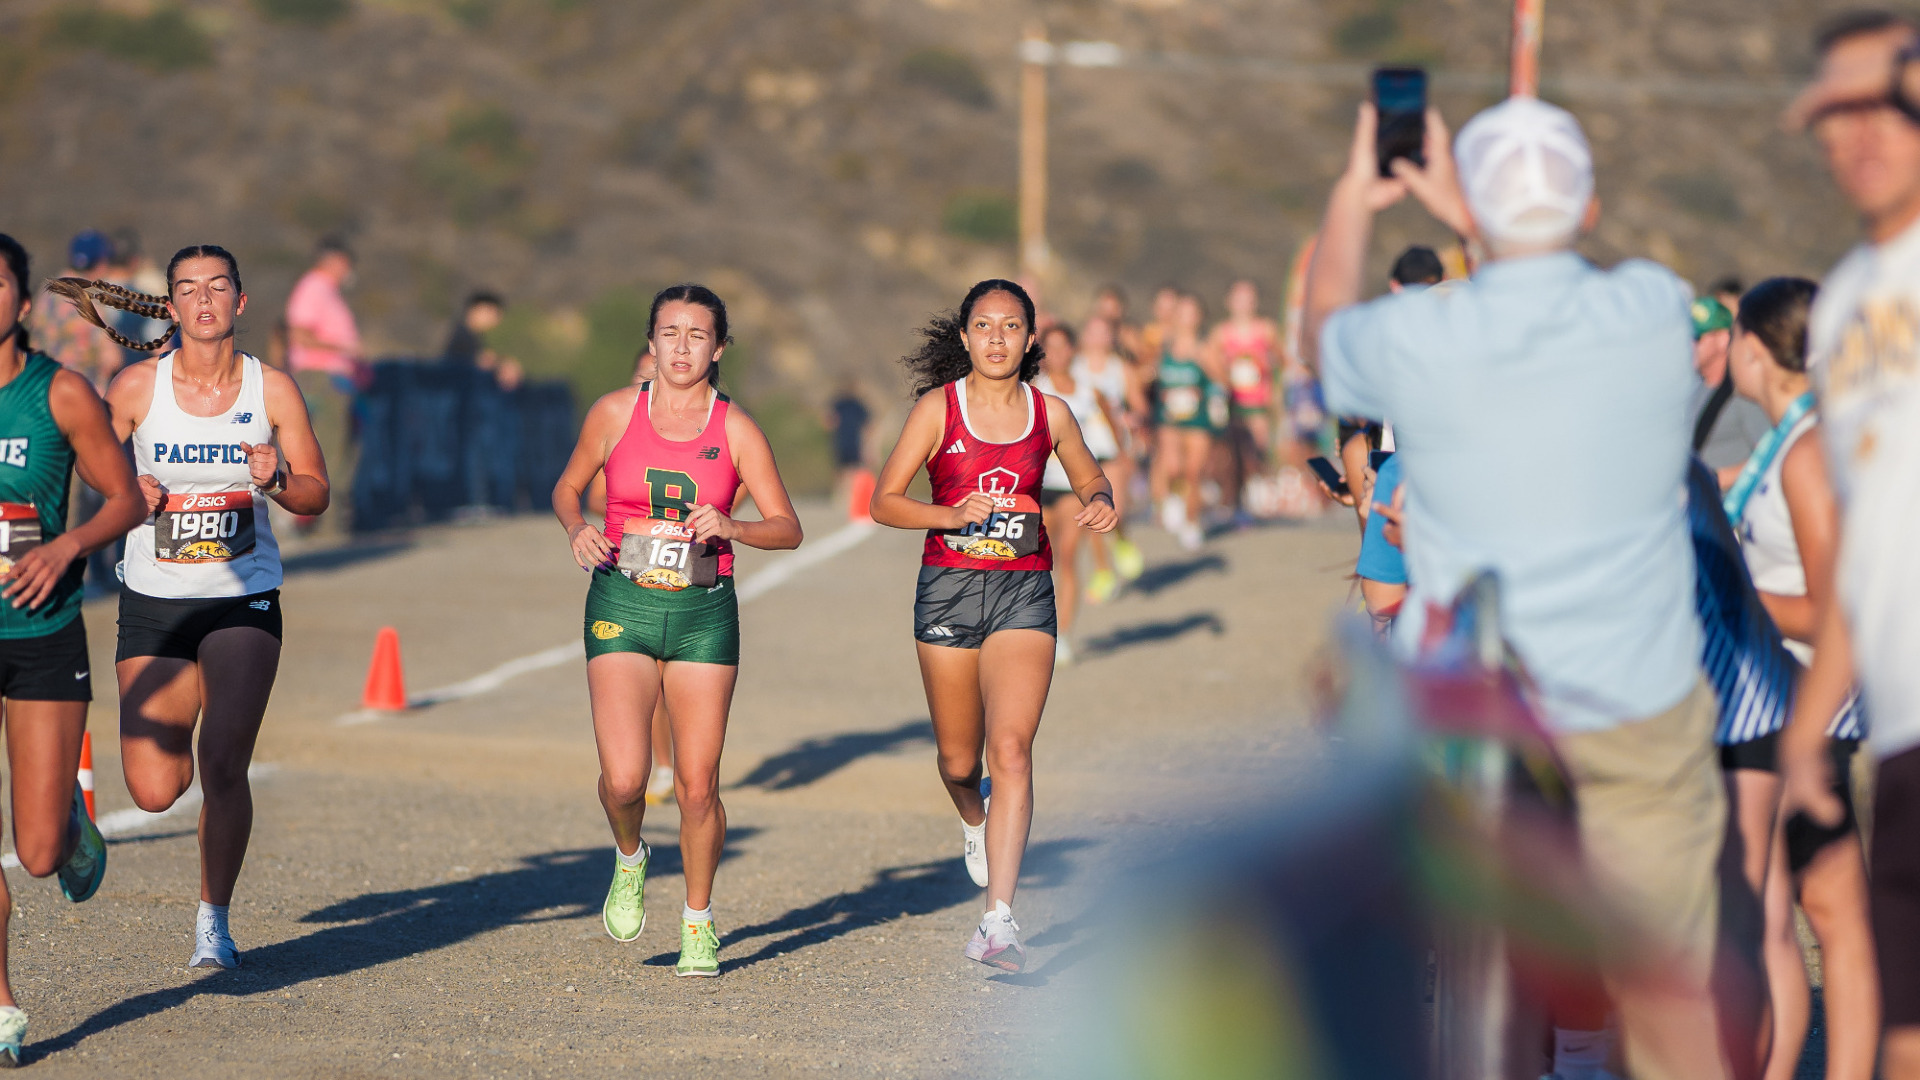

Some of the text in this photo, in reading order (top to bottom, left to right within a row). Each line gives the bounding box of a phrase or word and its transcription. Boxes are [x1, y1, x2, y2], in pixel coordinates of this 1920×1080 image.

[154, 443, 249, 464] PACIFIC
[644, 467, 698, 522] B
[989, 477, 1005, 494] L
[170, 511, 238, 540] 1980
[649, 539, 690, 569] 161
